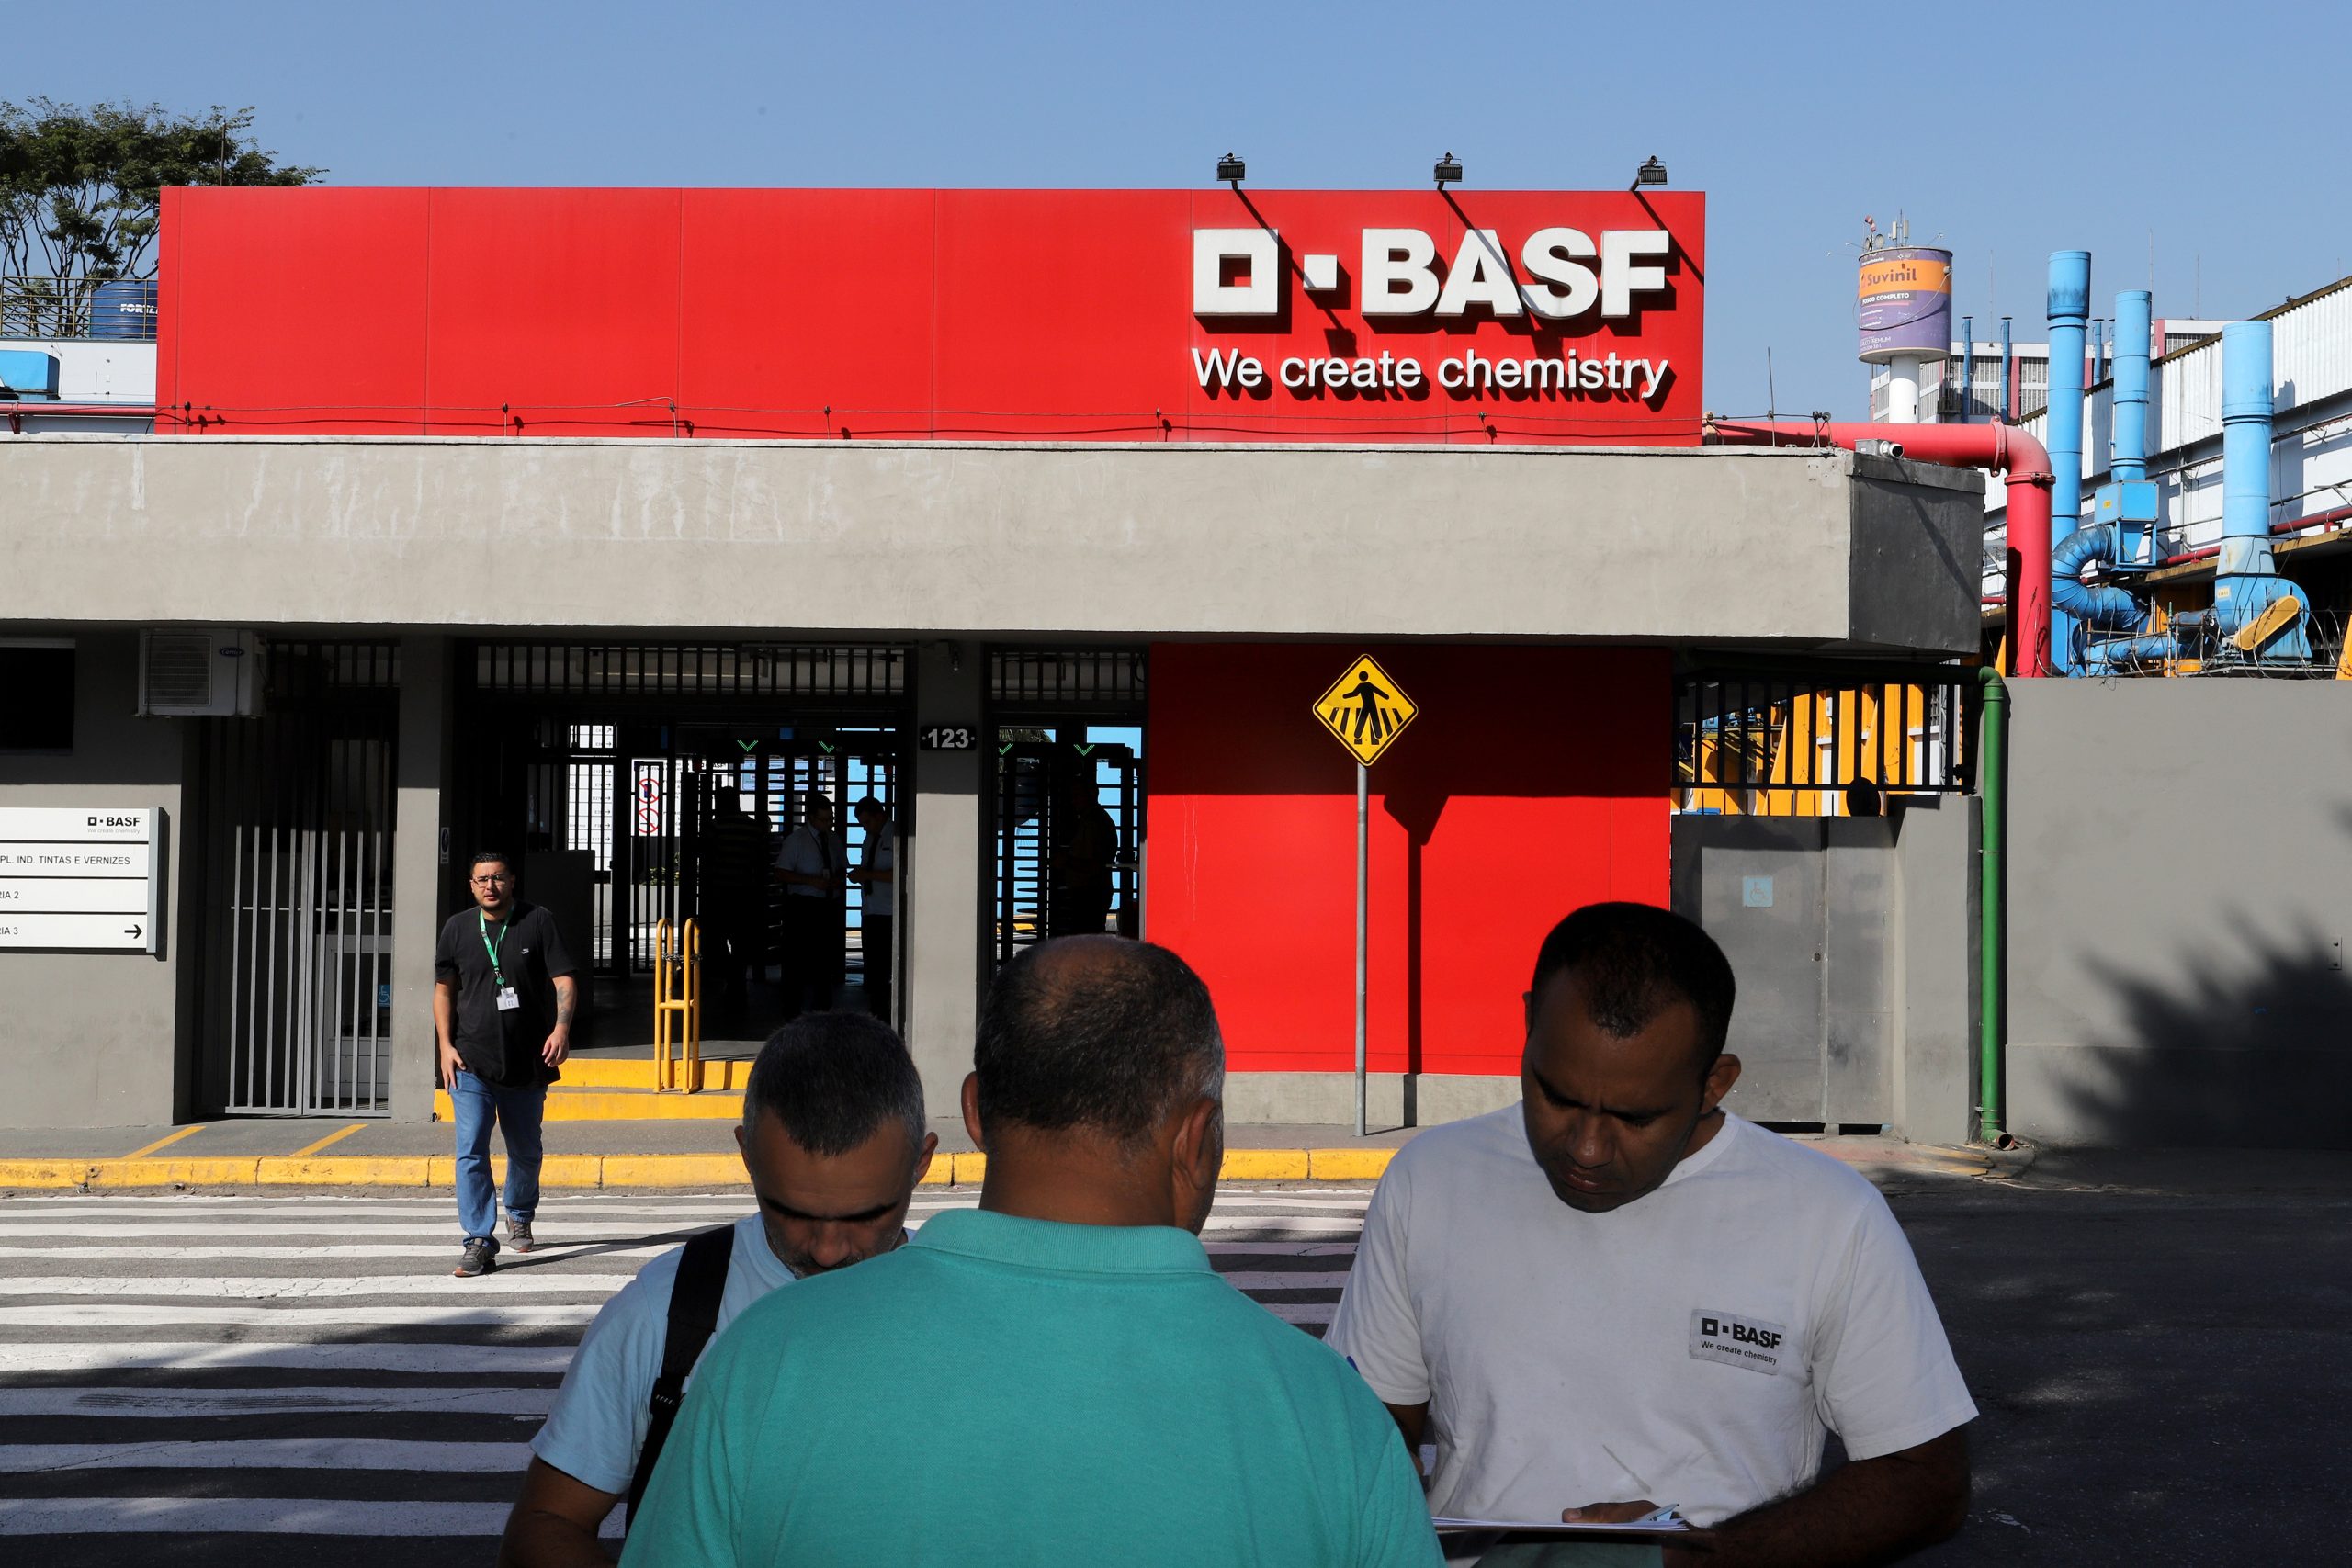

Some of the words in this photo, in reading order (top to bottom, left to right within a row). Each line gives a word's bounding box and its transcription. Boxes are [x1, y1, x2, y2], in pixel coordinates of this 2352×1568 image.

[1361, 227, 1670, 319] BASF
[1867, 268, 1917, 286] Suvinil
[1876, 292, 1910, 301] COMPLETO
[1192, 347, 1263, 389] We
[1280, 351, 1421, 389] create
[1438, 348, 1669, 399] chemistry
[928, 728, 969, 749] 123
[106, 817, 141, 827] BASF
[17, 855, 36, 864] IND.
[39, 855, 72, 864] TINTAS
[74, 856, 80, 864] E
[84, 856, 130, 865] VERNIZES
[14, 890, 19, 899] 2
[13, 926, 18, 935] 3
[1733, 1323, 1781, 1349] BASF
[1701, 1340, 1714, 1349] We
[1716, 1343, 1742, 1355] create
[1744, 1350, 1778, 1366] chemistry
